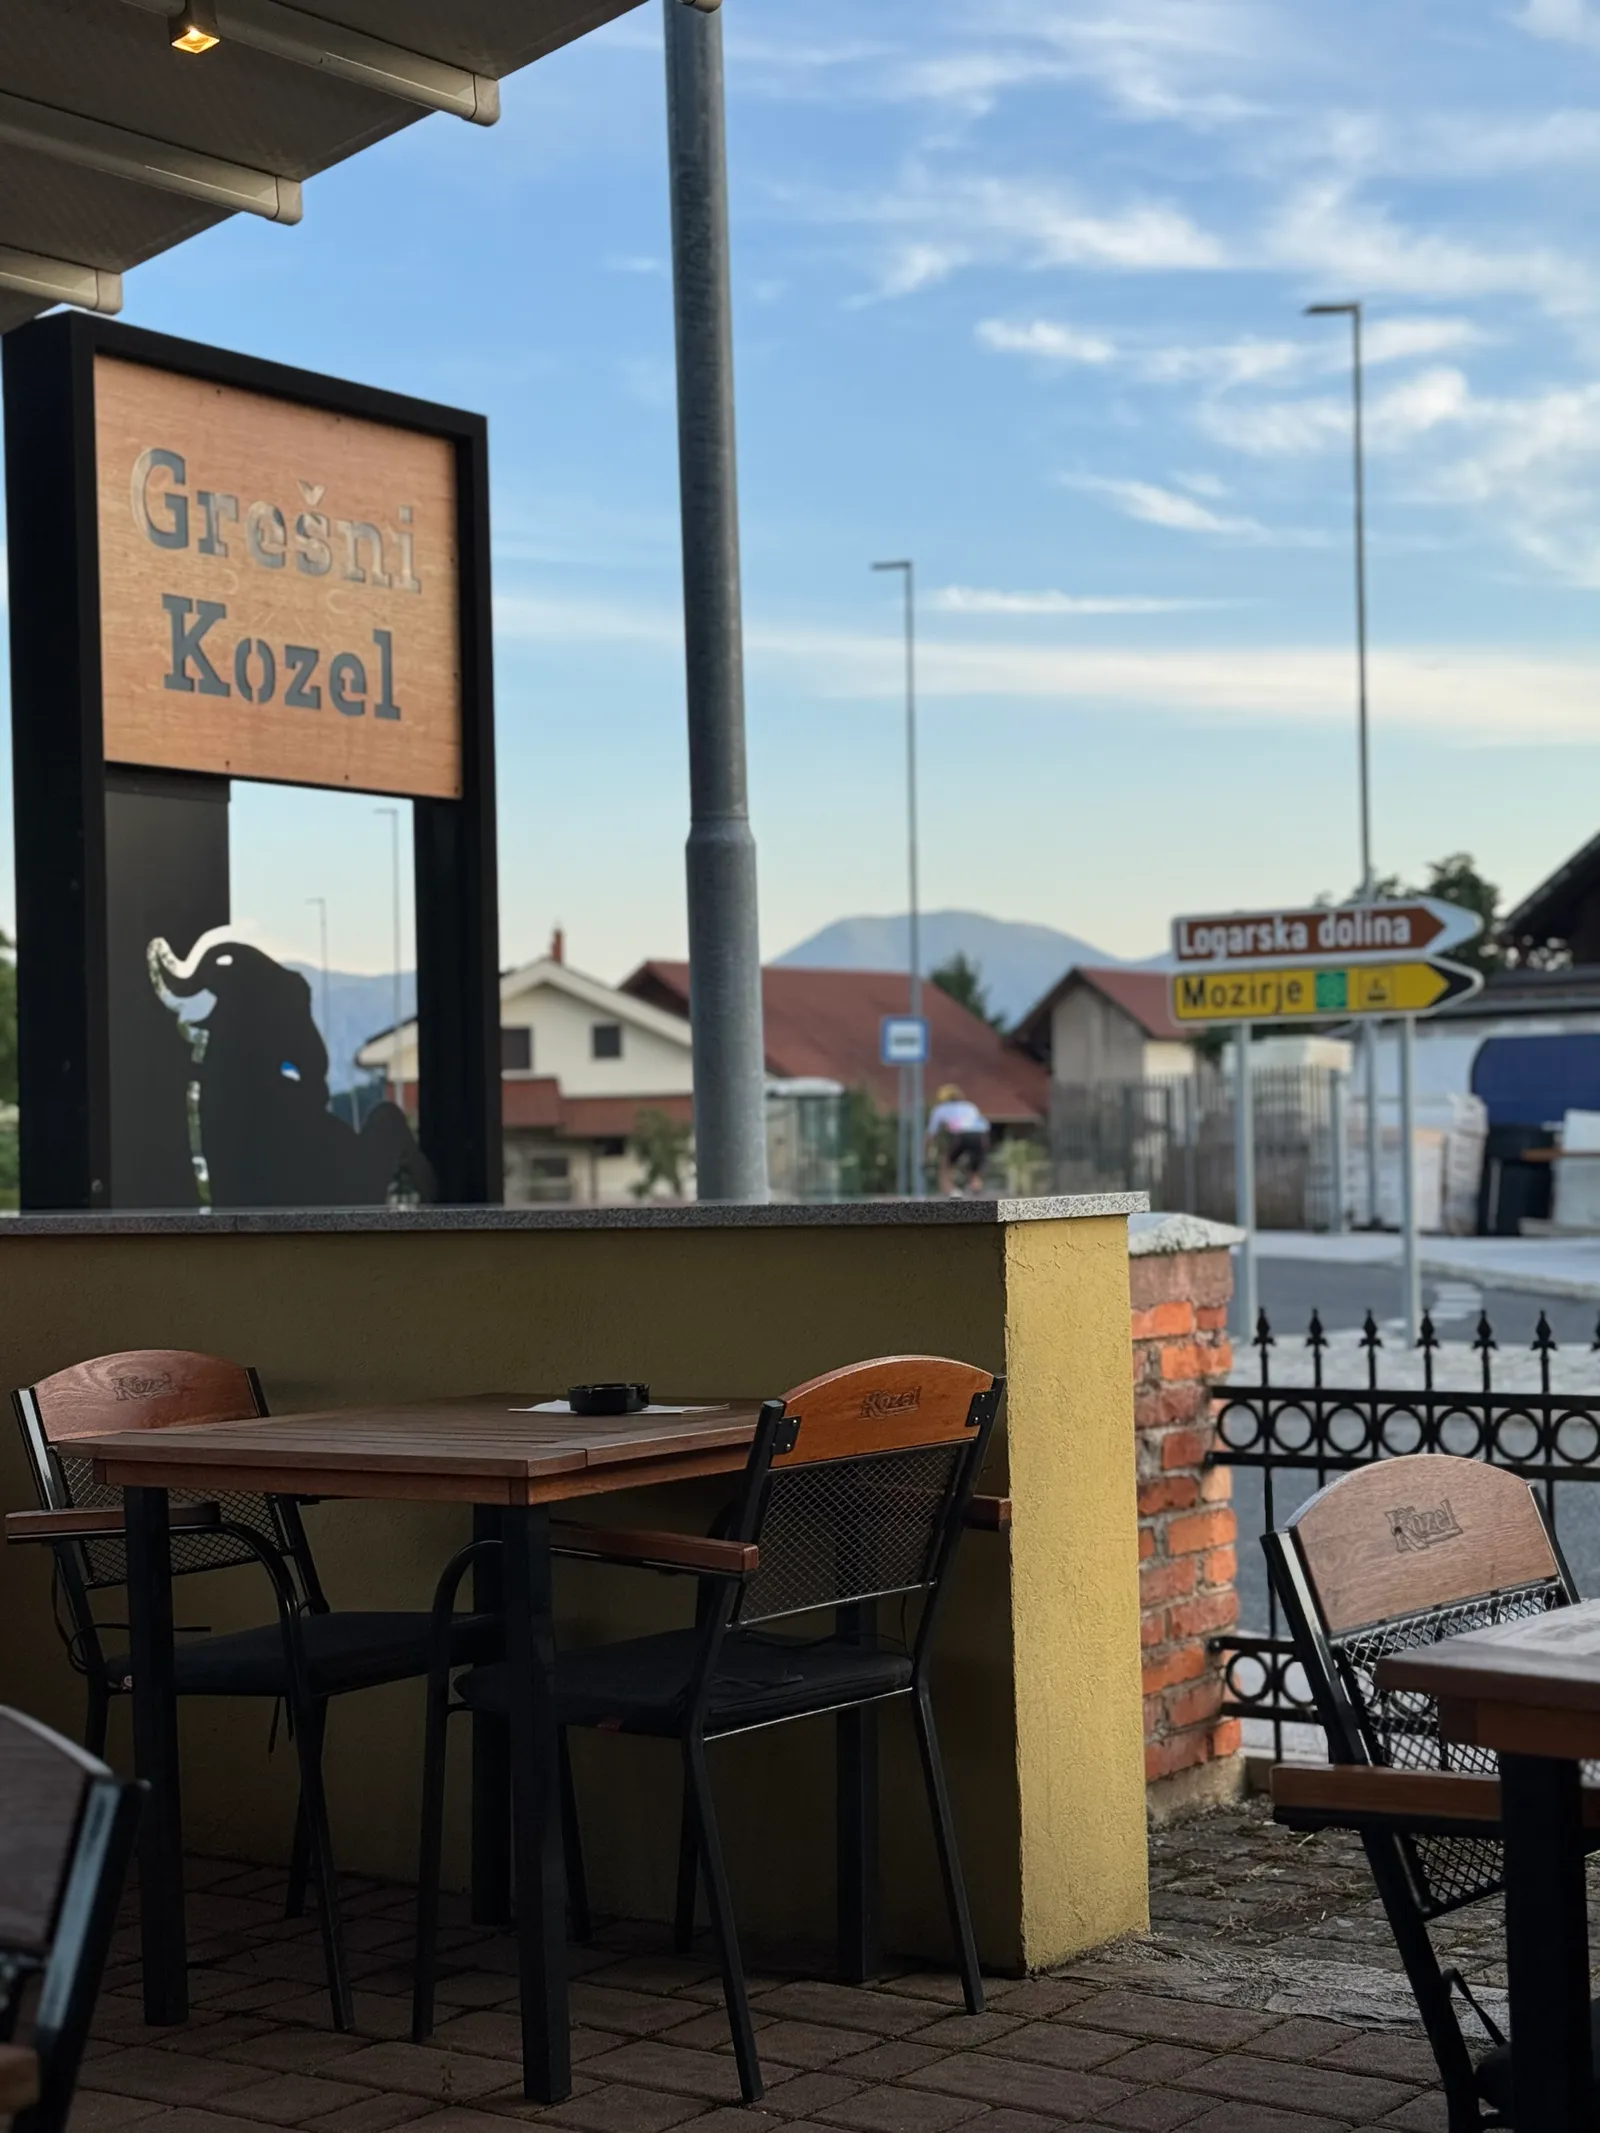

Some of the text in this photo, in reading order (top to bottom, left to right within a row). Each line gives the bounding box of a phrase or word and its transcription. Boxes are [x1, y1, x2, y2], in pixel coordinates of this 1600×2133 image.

[131, 447, 421, 594] Grešni
[162, 593, 401, 721] Kozel
[1178, 911, 1412, 960] Logarska dolina
[1183, 975, 1303, 1015] Mozirje
[858, 1386, 921, 1420] Kozel
[1384, 1498, 1463, 1553] Kozel
